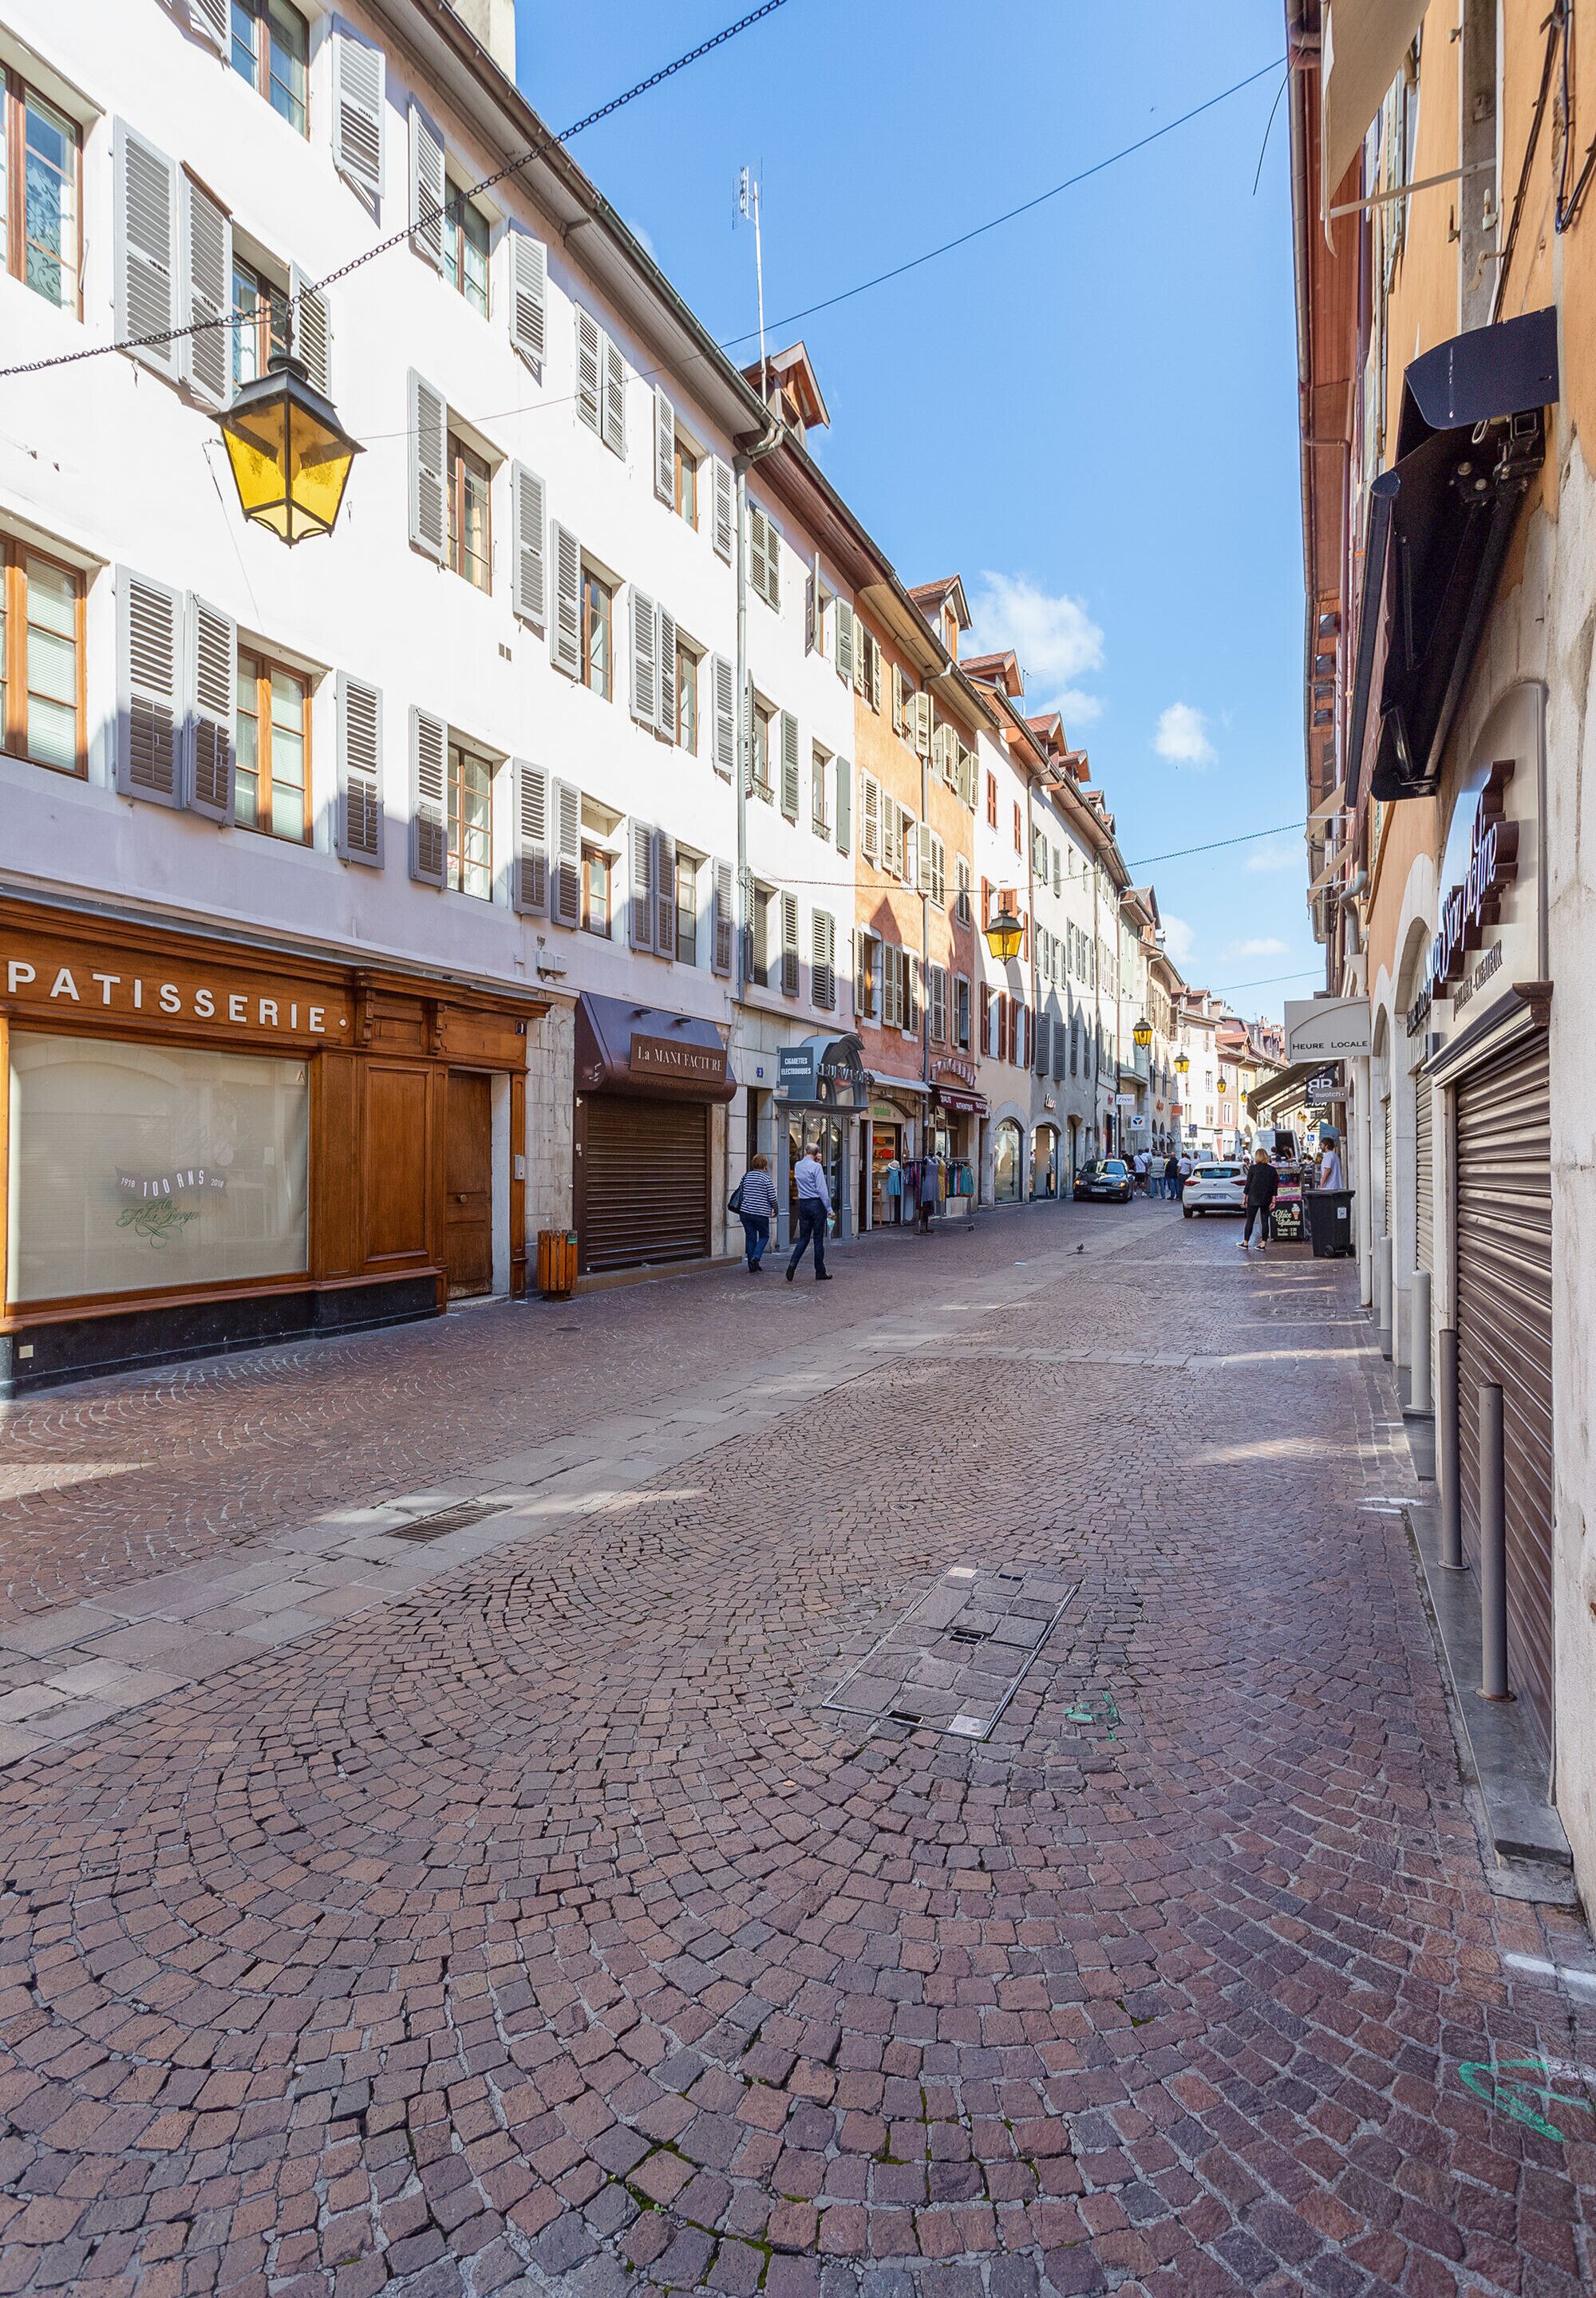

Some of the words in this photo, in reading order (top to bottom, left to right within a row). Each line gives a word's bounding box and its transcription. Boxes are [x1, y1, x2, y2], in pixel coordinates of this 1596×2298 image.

[7, 960, 326, 1033] PATISSERIE
[638, 1045, 650, 1060] La
[654, 1048, 722, 1072] MANUFACTURE
[120, 1177, 136, 1188] 1918
[144, 1179, 170, 1197] 100
[176, 1170, 204, 1188] ANS
[211, 1179, 224, 1188] 2018
